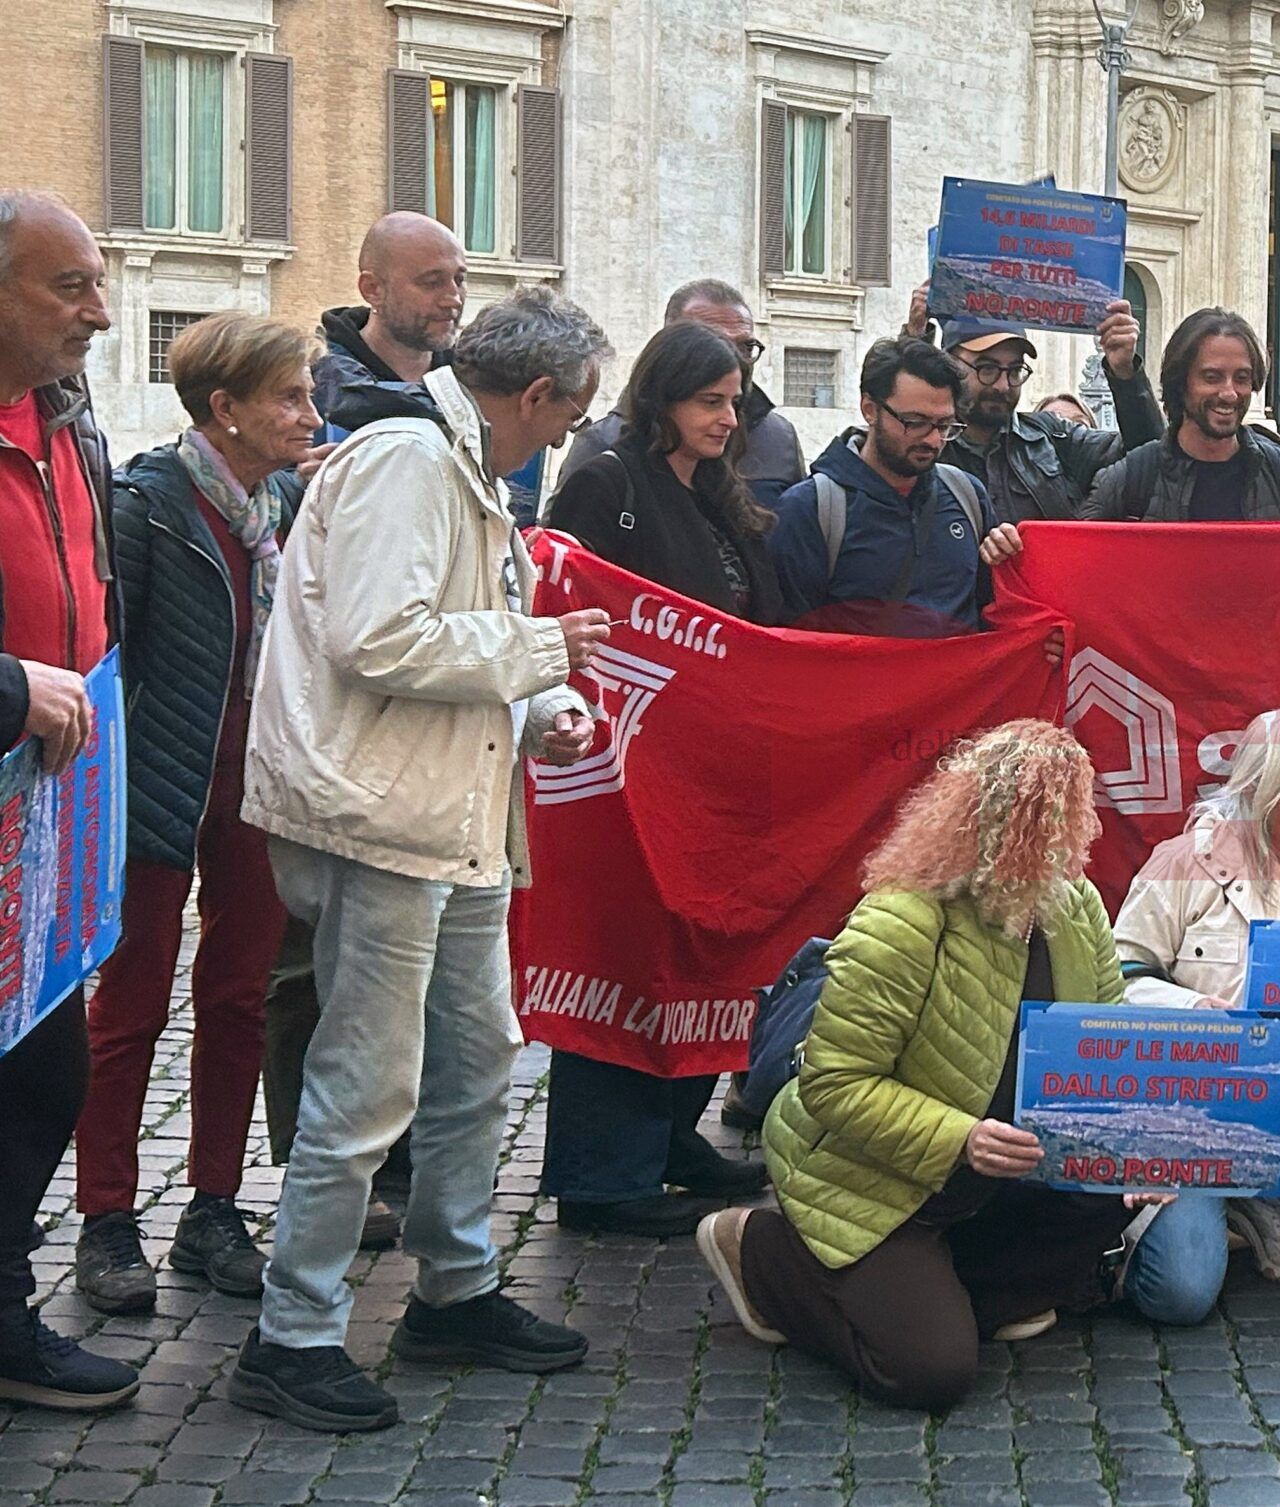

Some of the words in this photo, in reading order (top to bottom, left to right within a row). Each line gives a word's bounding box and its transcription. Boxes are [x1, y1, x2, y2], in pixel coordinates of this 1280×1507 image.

[981, 207, 1016, 227] 14,6
[1020, 211, 1096, 235] MILIARDI
[1000, 235, 1018, 251] DI
[1024, 239, 1074, 259] TASSE
[990, 263, 1023, 277] PER
[1029, 264, 1078, 285] TUTTI
[965, 292, 1003, 313] NO
[1006, 298, 1087, 323] PONTE
[1080, 1019, 1130, 1030] COMITATO
[1132, 1022, 1146, 1030] NO
[1148, 1022, 1178, 1032] PONTE
[1181, 1022, 1204, 1033] CAPO
[1208, 1024, 1244, 1034] PELORO
[1135, 1039, 1164, 1062] LE
[1170, 1040, 1240, 1063] MANI
[1043, 1072, 1138, 1098] DALLO
[1146, 1076, 1268, 1103] STRETTO
[1064, 1157, 1116, 1182] NO
[1123, 1157, 1233, 1184] PONTE
